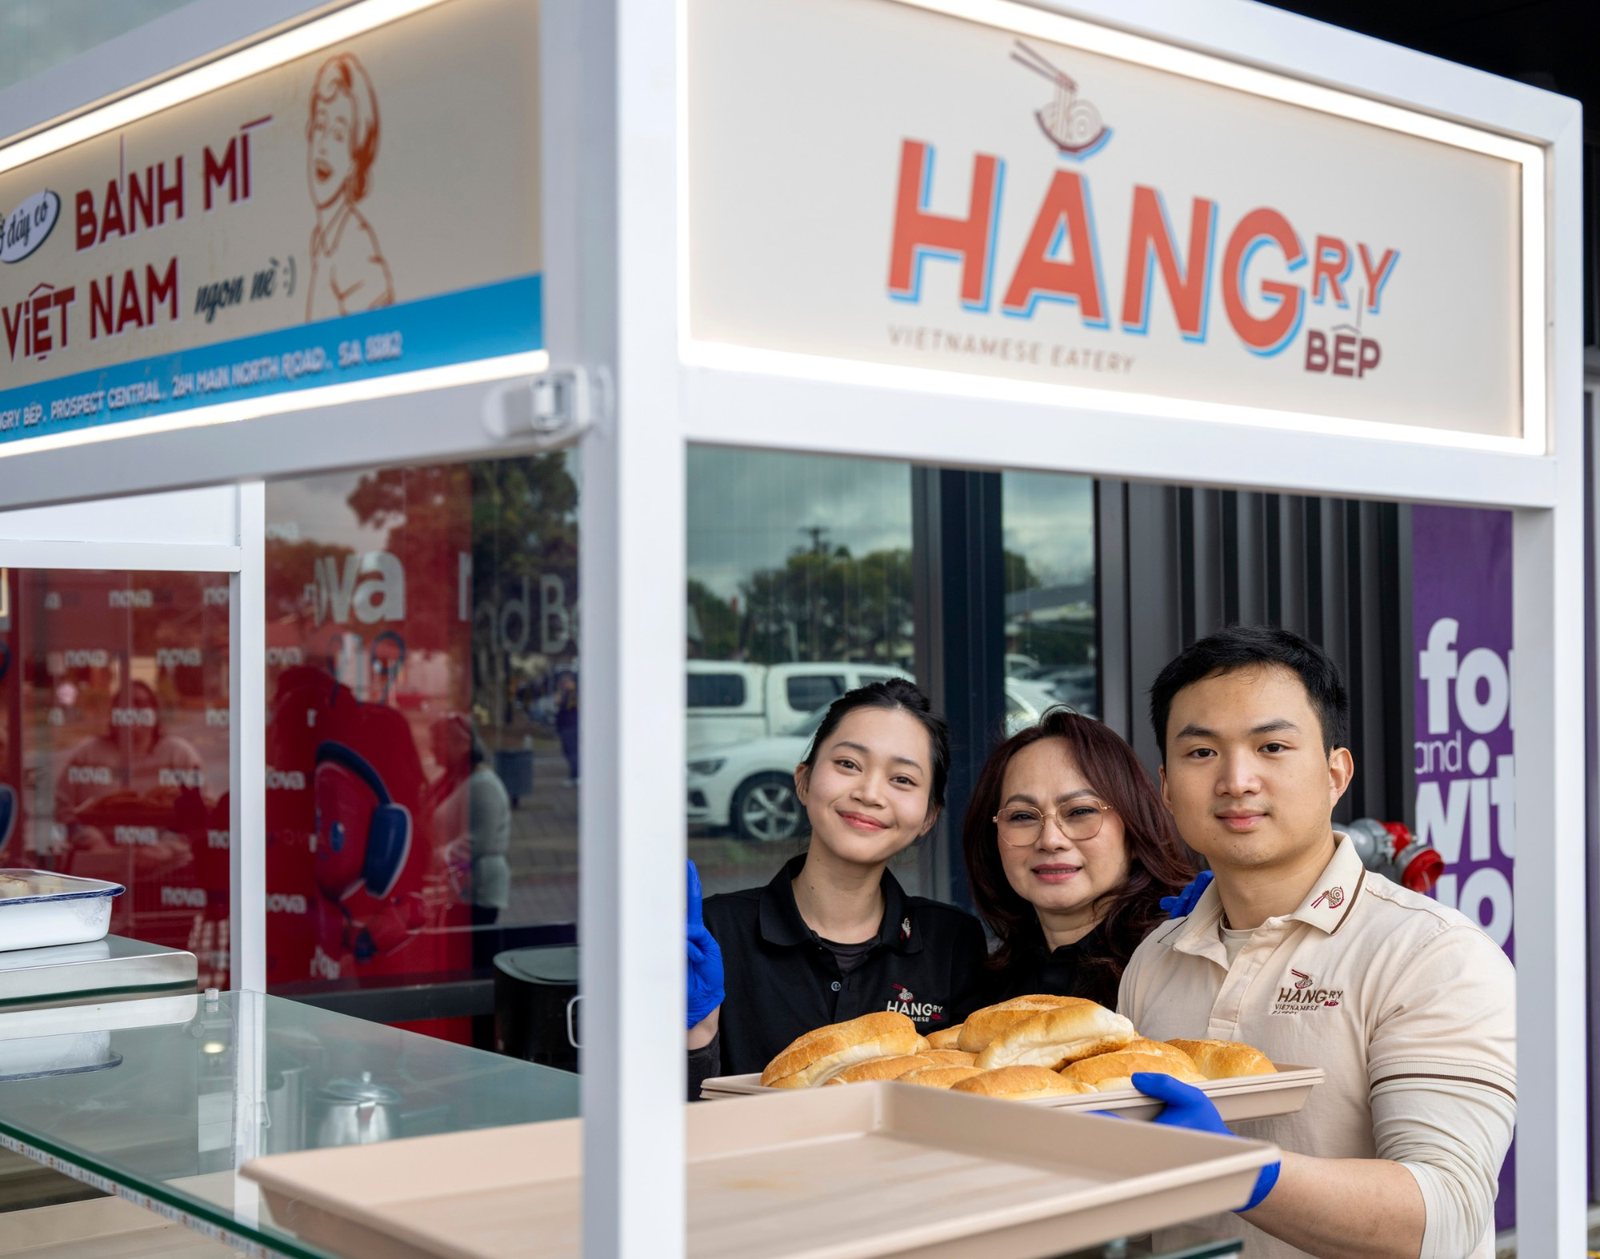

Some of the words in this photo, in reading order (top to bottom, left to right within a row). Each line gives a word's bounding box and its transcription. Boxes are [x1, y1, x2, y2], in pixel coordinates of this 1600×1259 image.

[89, 256, 180, 340] NAM
[887, 324, 1042, 364] VIETNAMESE
[1048, 343, 1136, 375] EATERY
[51, 390, 105, 420] PROSPECT
[196, 364, 230, 394] MAIN
[232, 354, 281, 387] NORTH
[109, 588, 154, 608] nova
[65, 650, 109, 667] nova
[157, 648, 202, 666] nova
[112, 706, 157, 726] nova
[69, 766, 112, 784] nova
[159, 768, 204, 788] nova
[115, 826, 159, 844] nova
[161, 886, 207, 907] nova
[1278, 987, 1343, 1003] HANGRY
